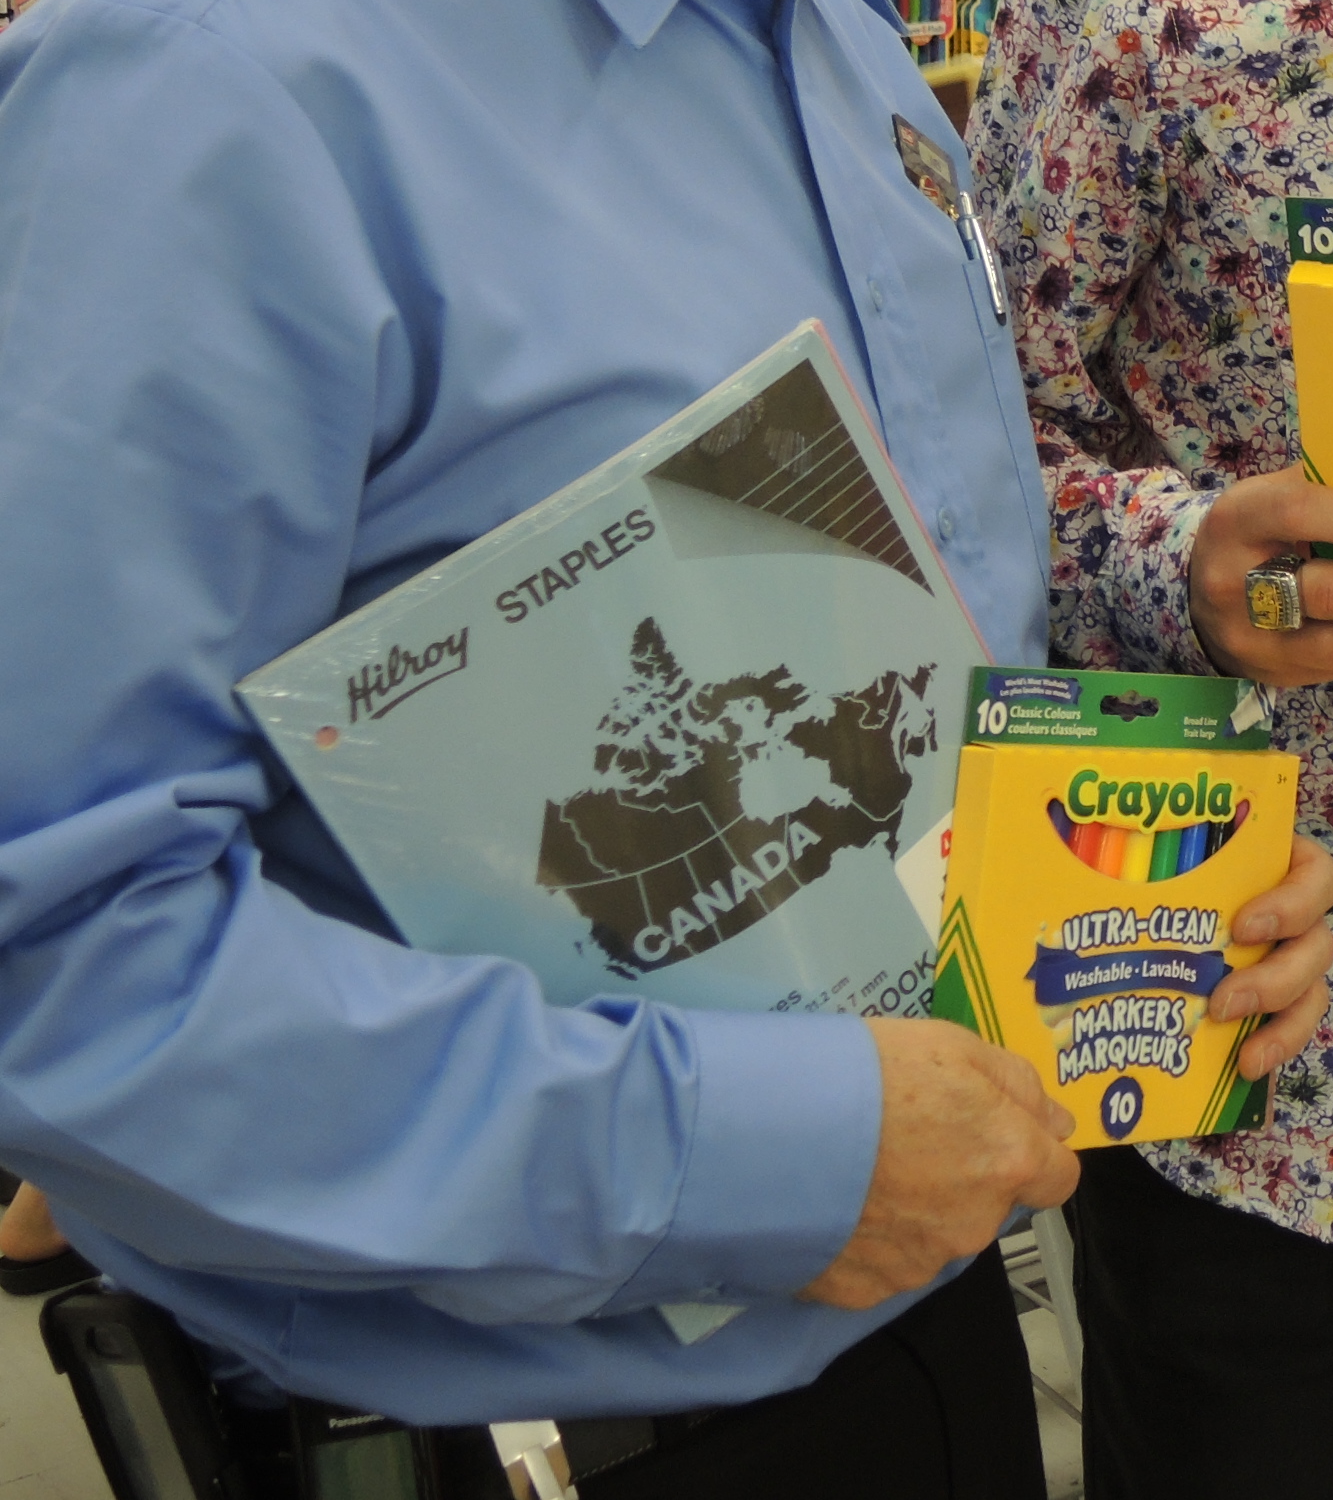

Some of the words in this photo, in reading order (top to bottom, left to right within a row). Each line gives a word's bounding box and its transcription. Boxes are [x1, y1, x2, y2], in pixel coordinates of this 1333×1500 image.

[495, 507, 656, 624] STAPLES
[347, 625, 470, 724] Hilroy
[976, 699, 1008, 735] 10
[1010, 705, 1044, 719] Classic
[1045, 707, 1081, 721] Colours
[1007, 722, 1050, 736] couleurs
[1050, 723, 1098, 738] classiques
[1183, 716, 1203, 727] Broad
[1183, 728, 1199, 738] Trait
[1199, 729, 1217, 740] large
[1276, 773, 1288, 785] 3+
[1067, 769, 1232, 829] Crayola
[633, 820, 822, 962] CANADA
[1063, 906, 1218, 951] ULTRA-CLEAN
[860, 969, 889, 998] mm
[1064, 960, 1133, 992] Washable
[1141, 959, 1197, 983] Lavables
[768, 989, 802, 1013] es
[1074, 997, 1185, 1043] MARKERS
[1058, 1033, 1192, 1087] MARQUEURS
[1108, 1090, 1137, 1125] 10
